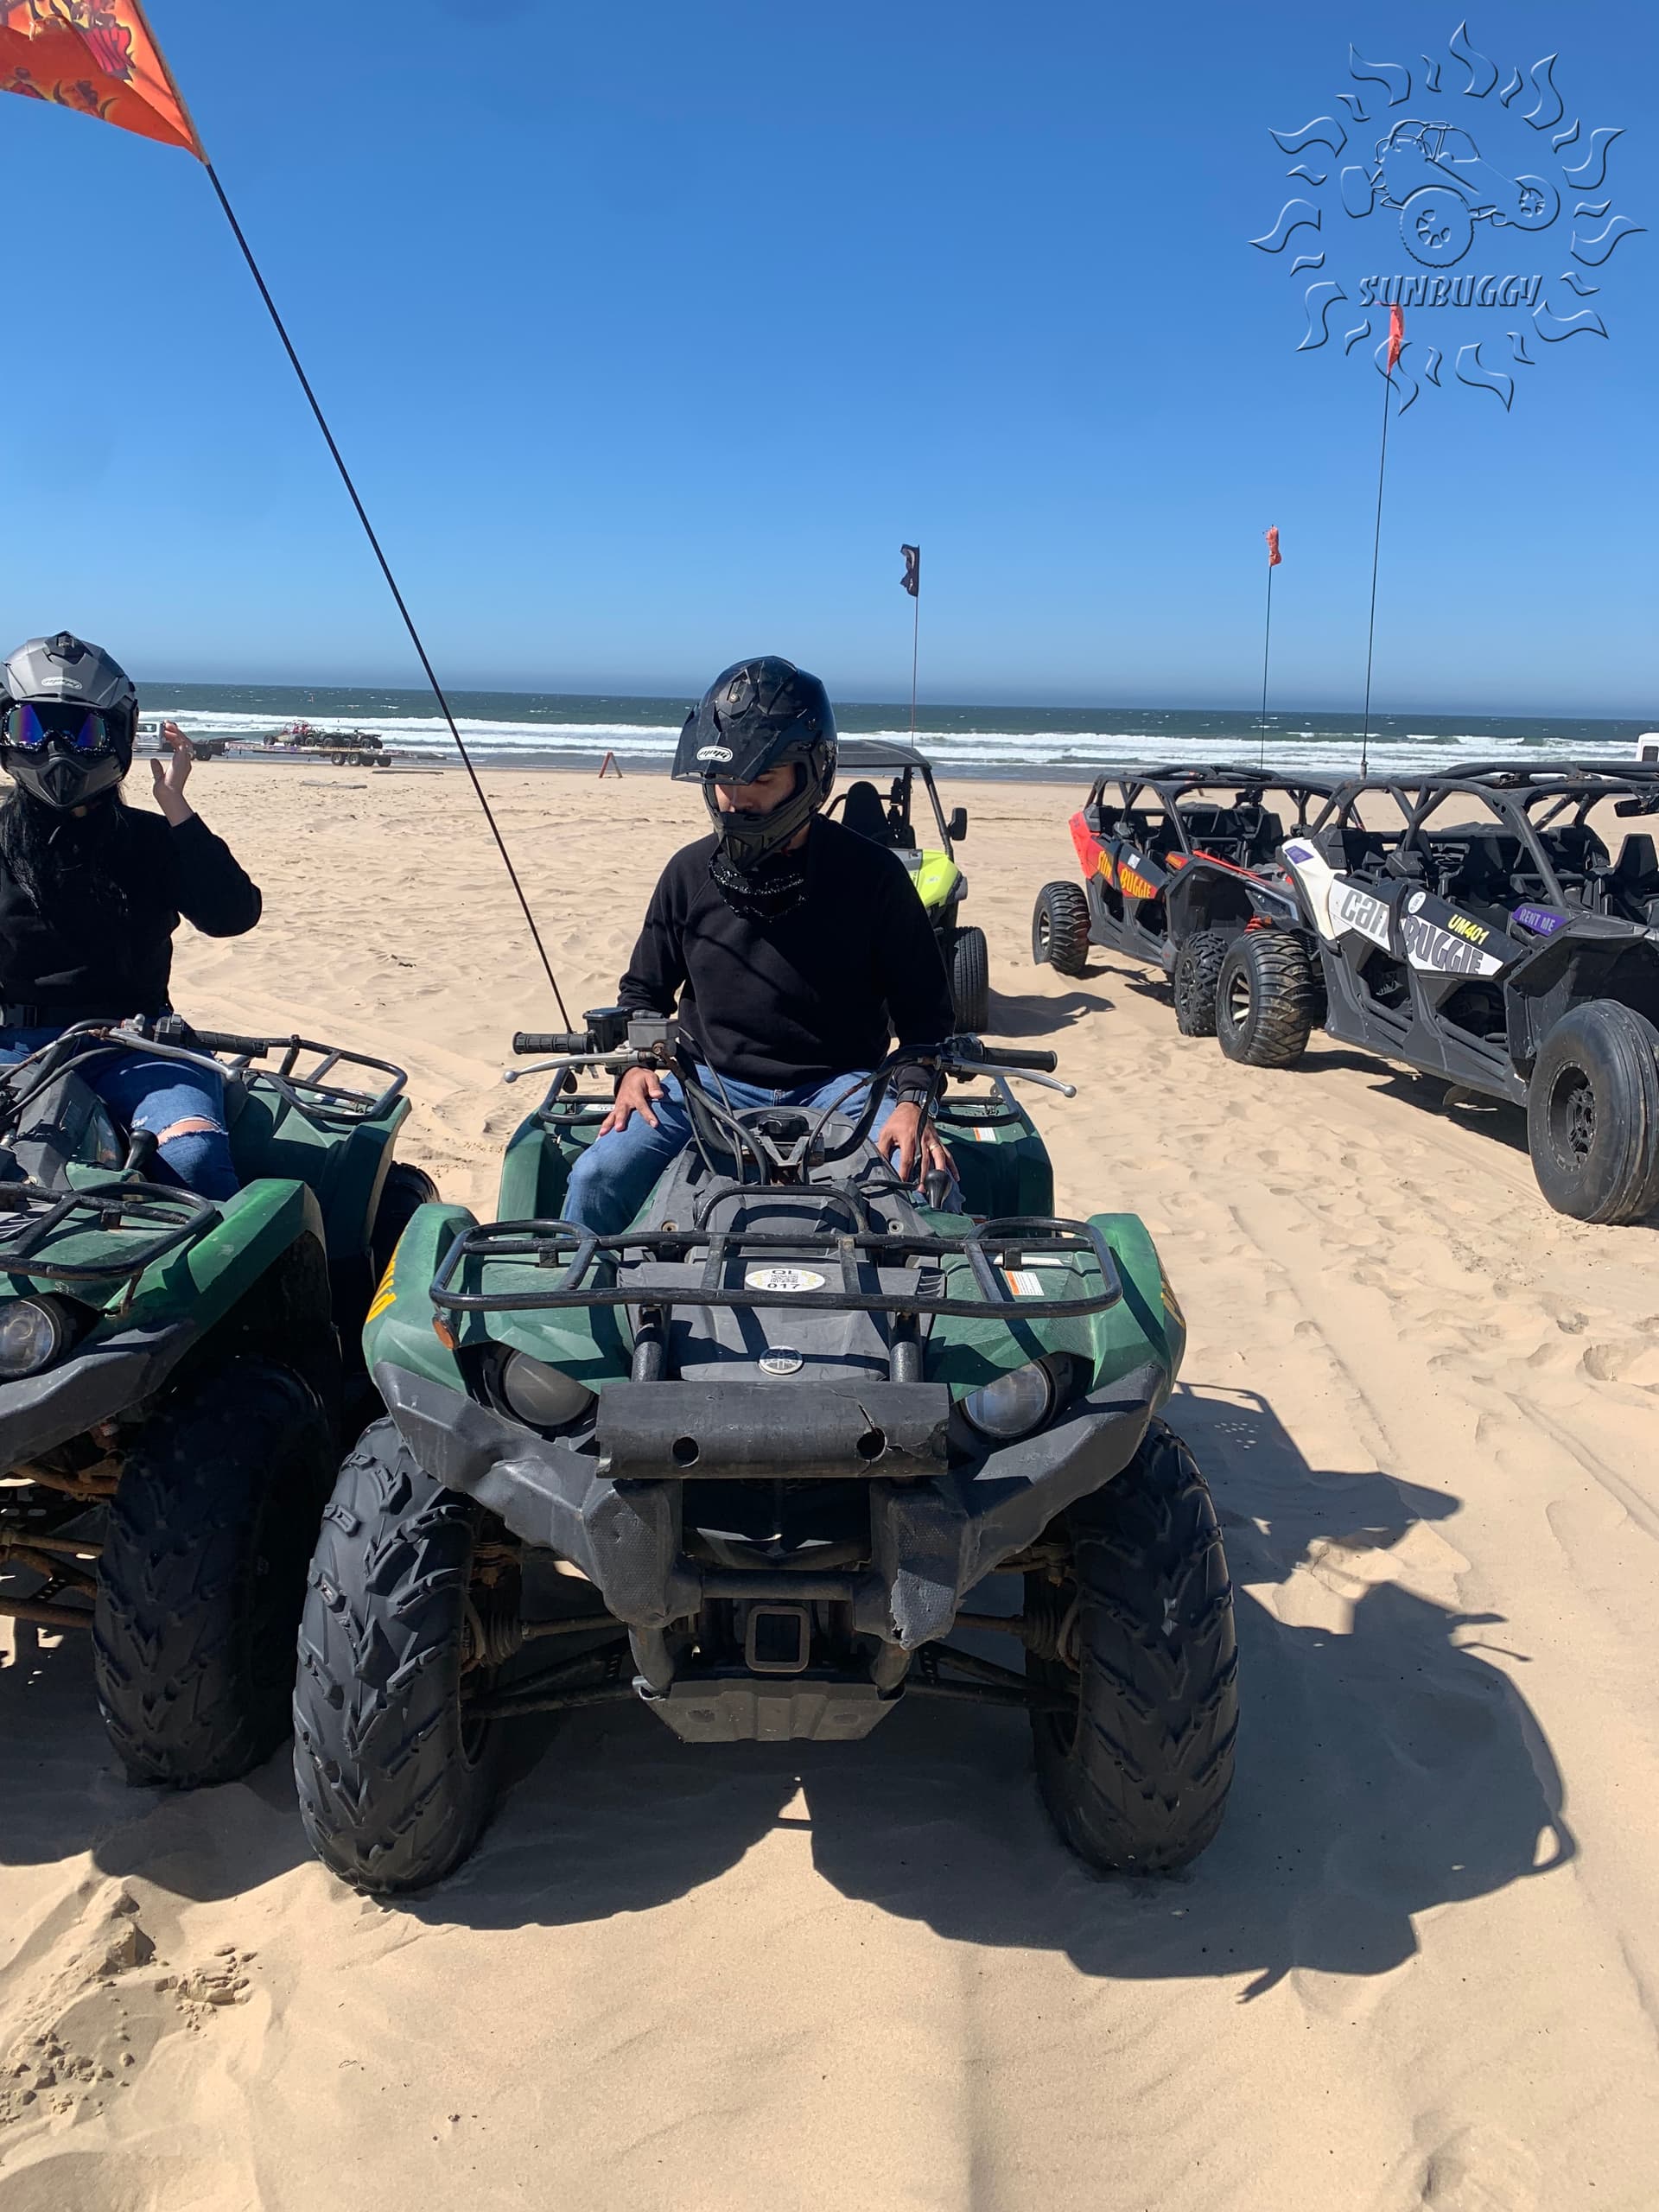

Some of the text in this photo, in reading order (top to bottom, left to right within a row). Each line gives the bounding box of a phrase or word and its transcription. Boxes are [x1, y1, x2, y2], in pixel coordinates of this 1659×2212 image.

[1120, 867, 1153, 899] BUGGIE
[1447, 913, 1491, 946] UM401
[1519, 908, 1556, 932] RENT ME
[1403, 916, 1484, 975] BUGGIE
